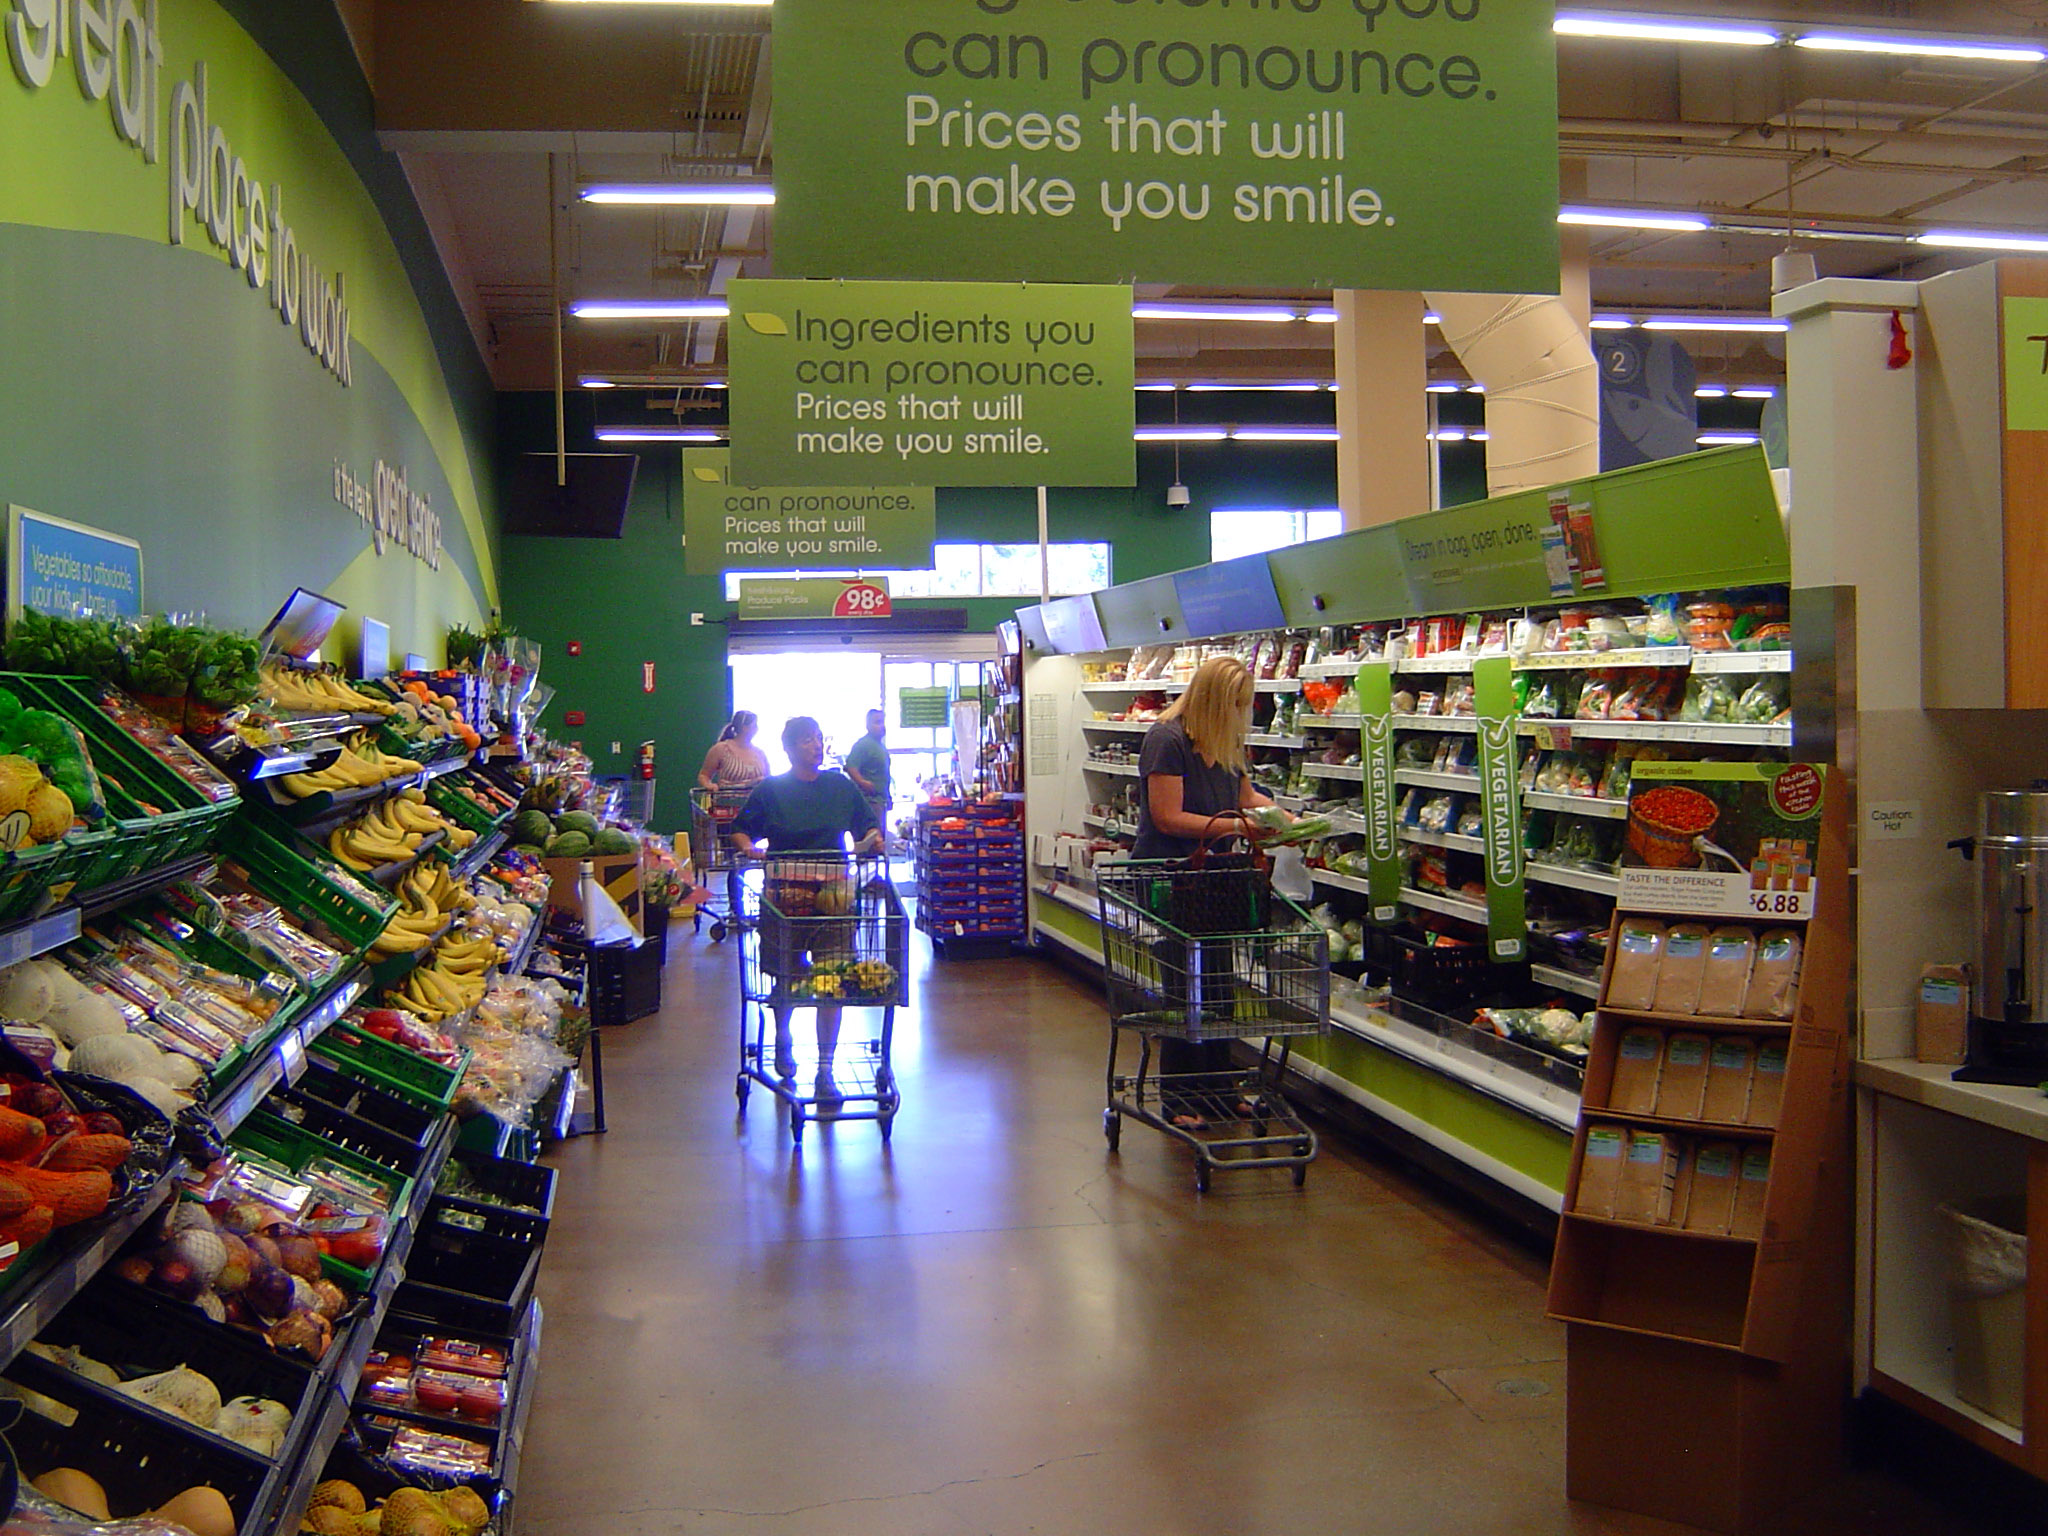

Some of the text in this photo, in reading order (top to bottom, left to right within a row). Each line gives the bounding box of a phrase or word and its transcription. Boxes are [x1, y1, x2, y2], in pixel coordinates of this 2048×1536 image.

[904, 31, 1497, 101] can pronounce.
[906, 94, 1345, 160] Prices that will
[906, 164, 1396, 231] make you smile.
[169, 60, 267, 288] place
[268, 183, 300, 325] to
[299, 252, 352, 388] work
[795, 309, 1096, 352] Ingredients you
[795, 358, 1104, 393] can pronounce.
[1612, 351, 1626, 372] 2
[796, 392, 1023, 421] Prices that will
[796, 427, 1050, 460] make you smile.
[373, 458, 408, 556] great
[406, 491, 442, 572] service
[724, 494, 915, 516] can pronounce.
[725, 515, 865, 533] Prices that will
[1471, 527, 1504, 554] open,
[1503, 519, 1538, 545] done.
[725, 536, 882, 557] make you smile.
[32, 544, 134, 594] Vegetables so affordable,
[846, 589, 884, 610] 98¢
[1371, 745, 1389, 851] VEGETARIAN
[1490, 753, 1512, 875] VEGETARIAN
[1884, 820, 1901, 831] Hot
[1625, 873, 1726, 888] TASTE THE DIFFERENCE
[1749, 894, 1800, 914] $6.88
